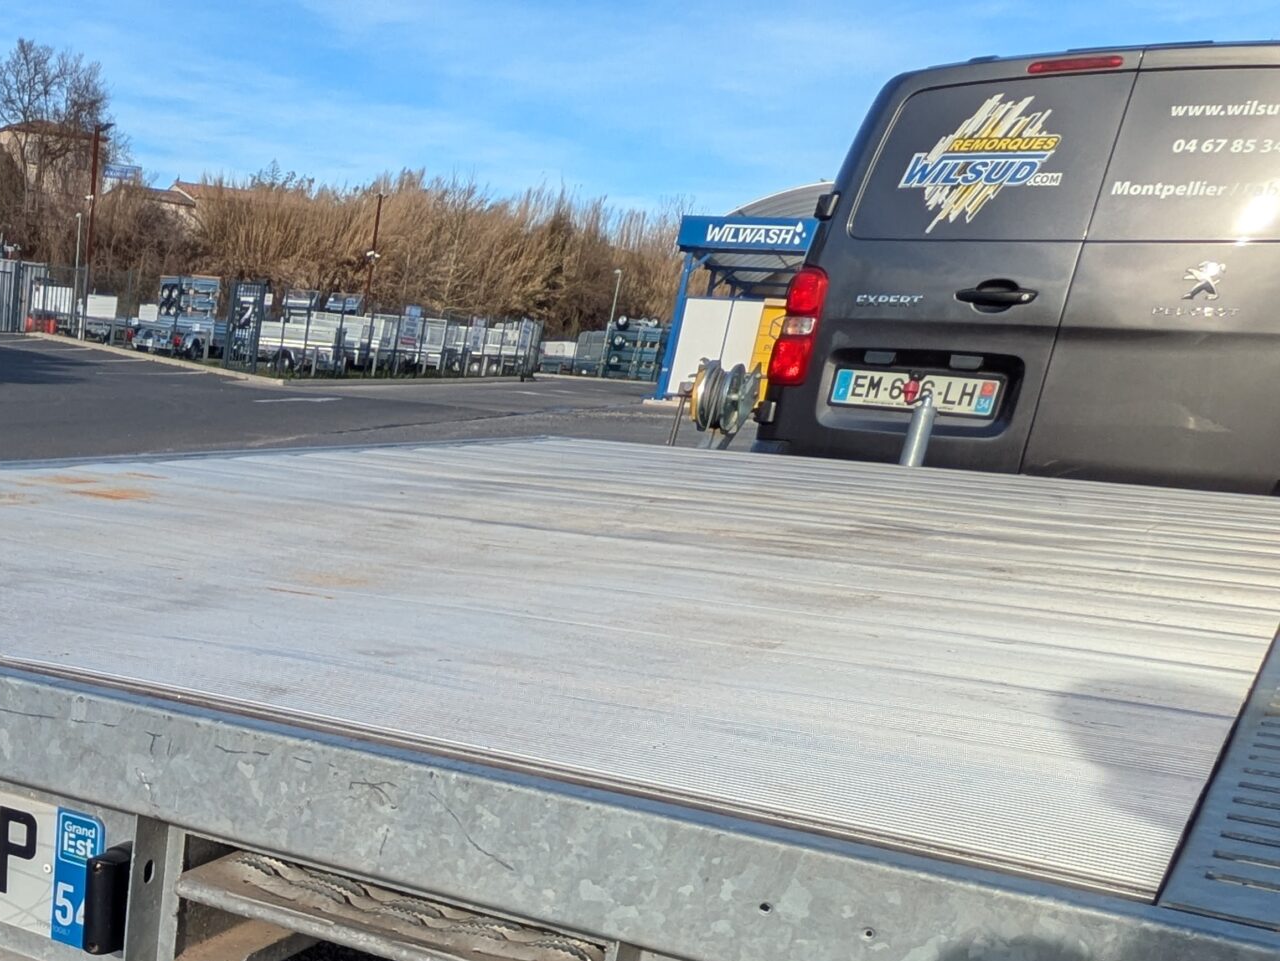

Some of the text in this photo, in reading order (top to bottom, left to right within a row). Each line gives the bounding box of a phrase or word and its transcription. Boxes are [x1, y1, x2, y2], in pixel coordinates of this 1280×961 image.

[949, 137, 1059, 151] REMORQUES
[1172, 139, 1198, 153] 04
[1201, 139, 1228, 153] 67
[1230, 139, 1257, 153] 85
[1111, 181, 1227, 199] Montpellier
[705, 224, 797, 245] WILWASH
[856, 294, 924, 307] EXPERT
[851, 374, 977, 407] EM-66-LH
[976, 397, 990, 410] 34
[64, 820, 96, 839] Grand
[63, 831, 95, 858] Est
